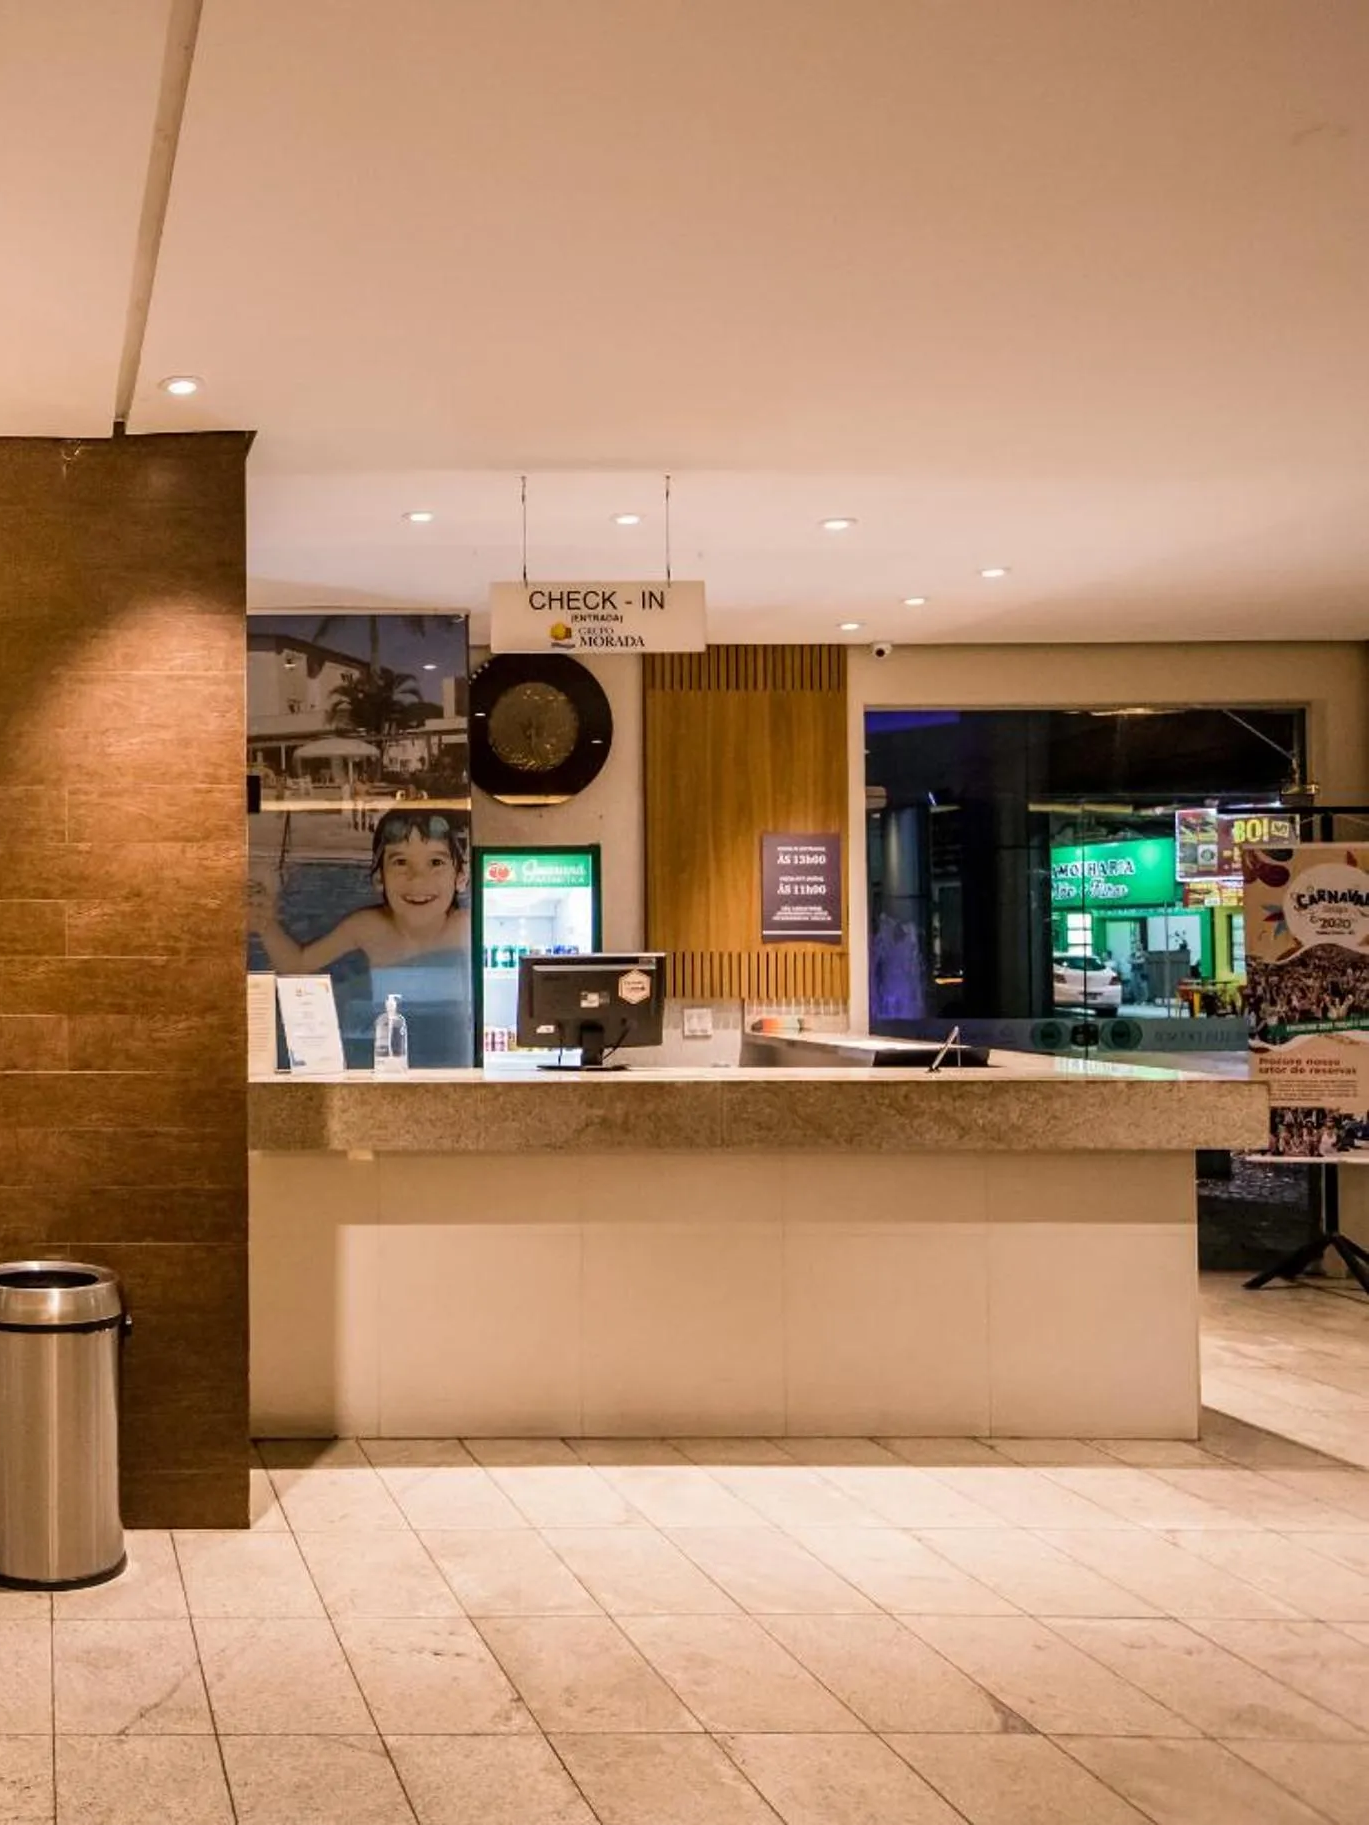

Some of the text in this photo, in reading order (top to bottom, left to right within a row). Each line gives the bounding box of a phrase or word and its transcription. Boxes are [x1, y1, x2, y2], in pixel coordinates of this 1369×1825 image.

[528, 590, 618, 611] CHECK
[641, 591, 665, 610] IN
[571, 614, 623, 623] (ENTRADA)
[579, 635, 645, 648] MORADA
